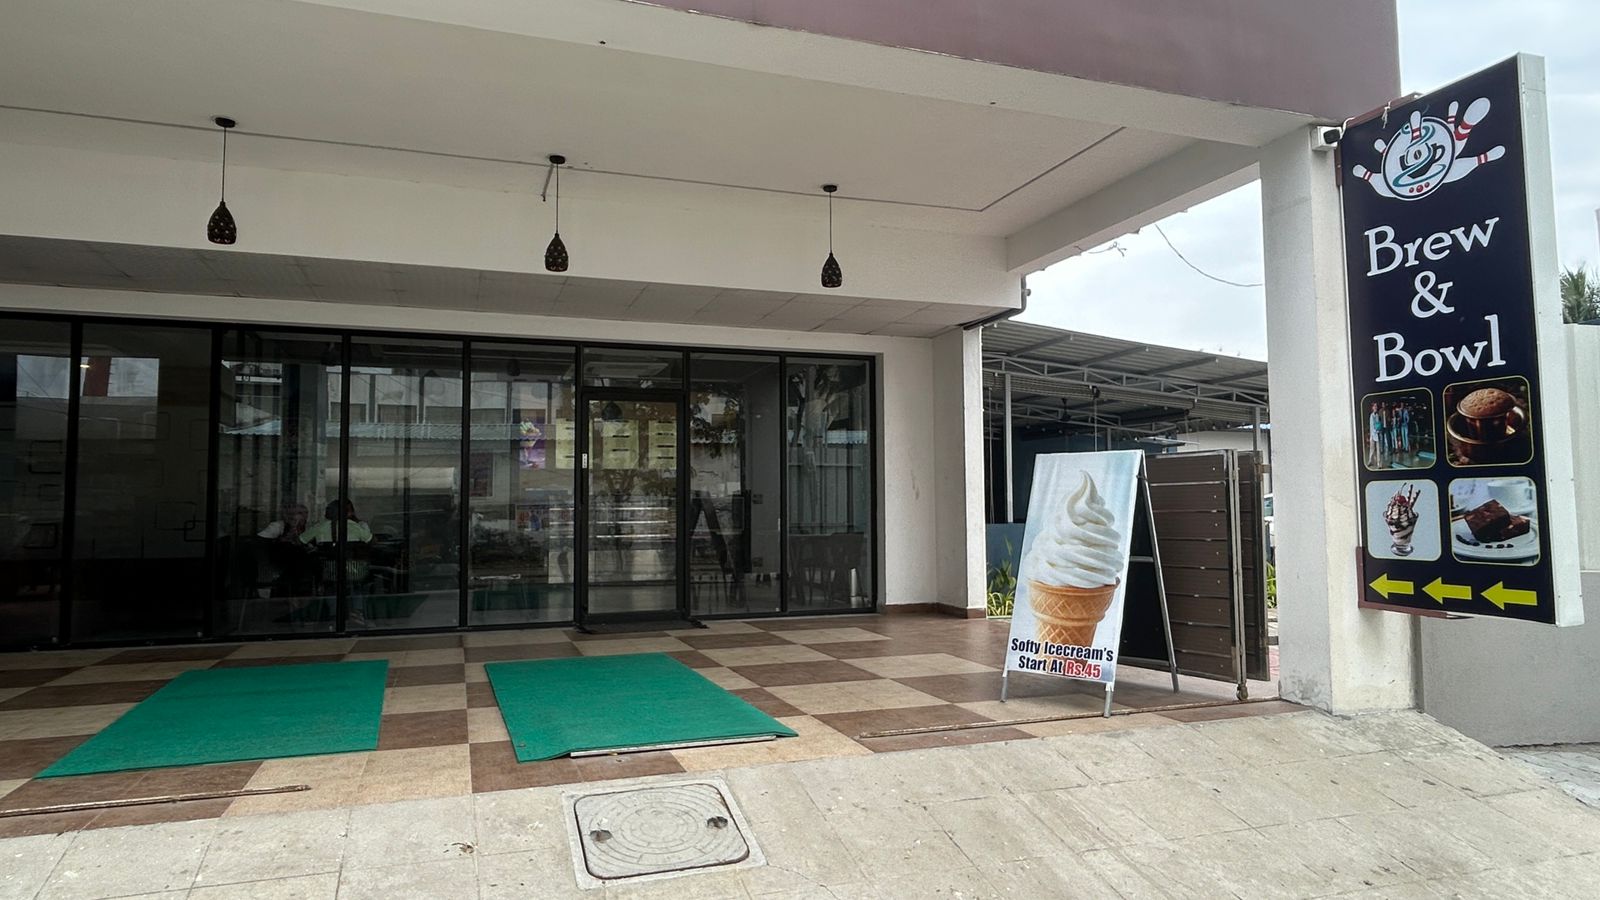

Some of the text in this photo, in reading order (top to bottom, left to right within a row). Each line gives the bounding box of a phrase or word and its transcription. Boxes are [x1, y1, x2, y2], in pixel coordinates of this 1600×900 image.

[1364, 216, 1500, 277] Brew
[1410, 270, 1455, 319] &
[1373, 313, 1506, 382] Bowl
[1011, 637, 1114, 662] Softy Icecream's
[1018, 655, 1101, 678] Start At Rs.45
